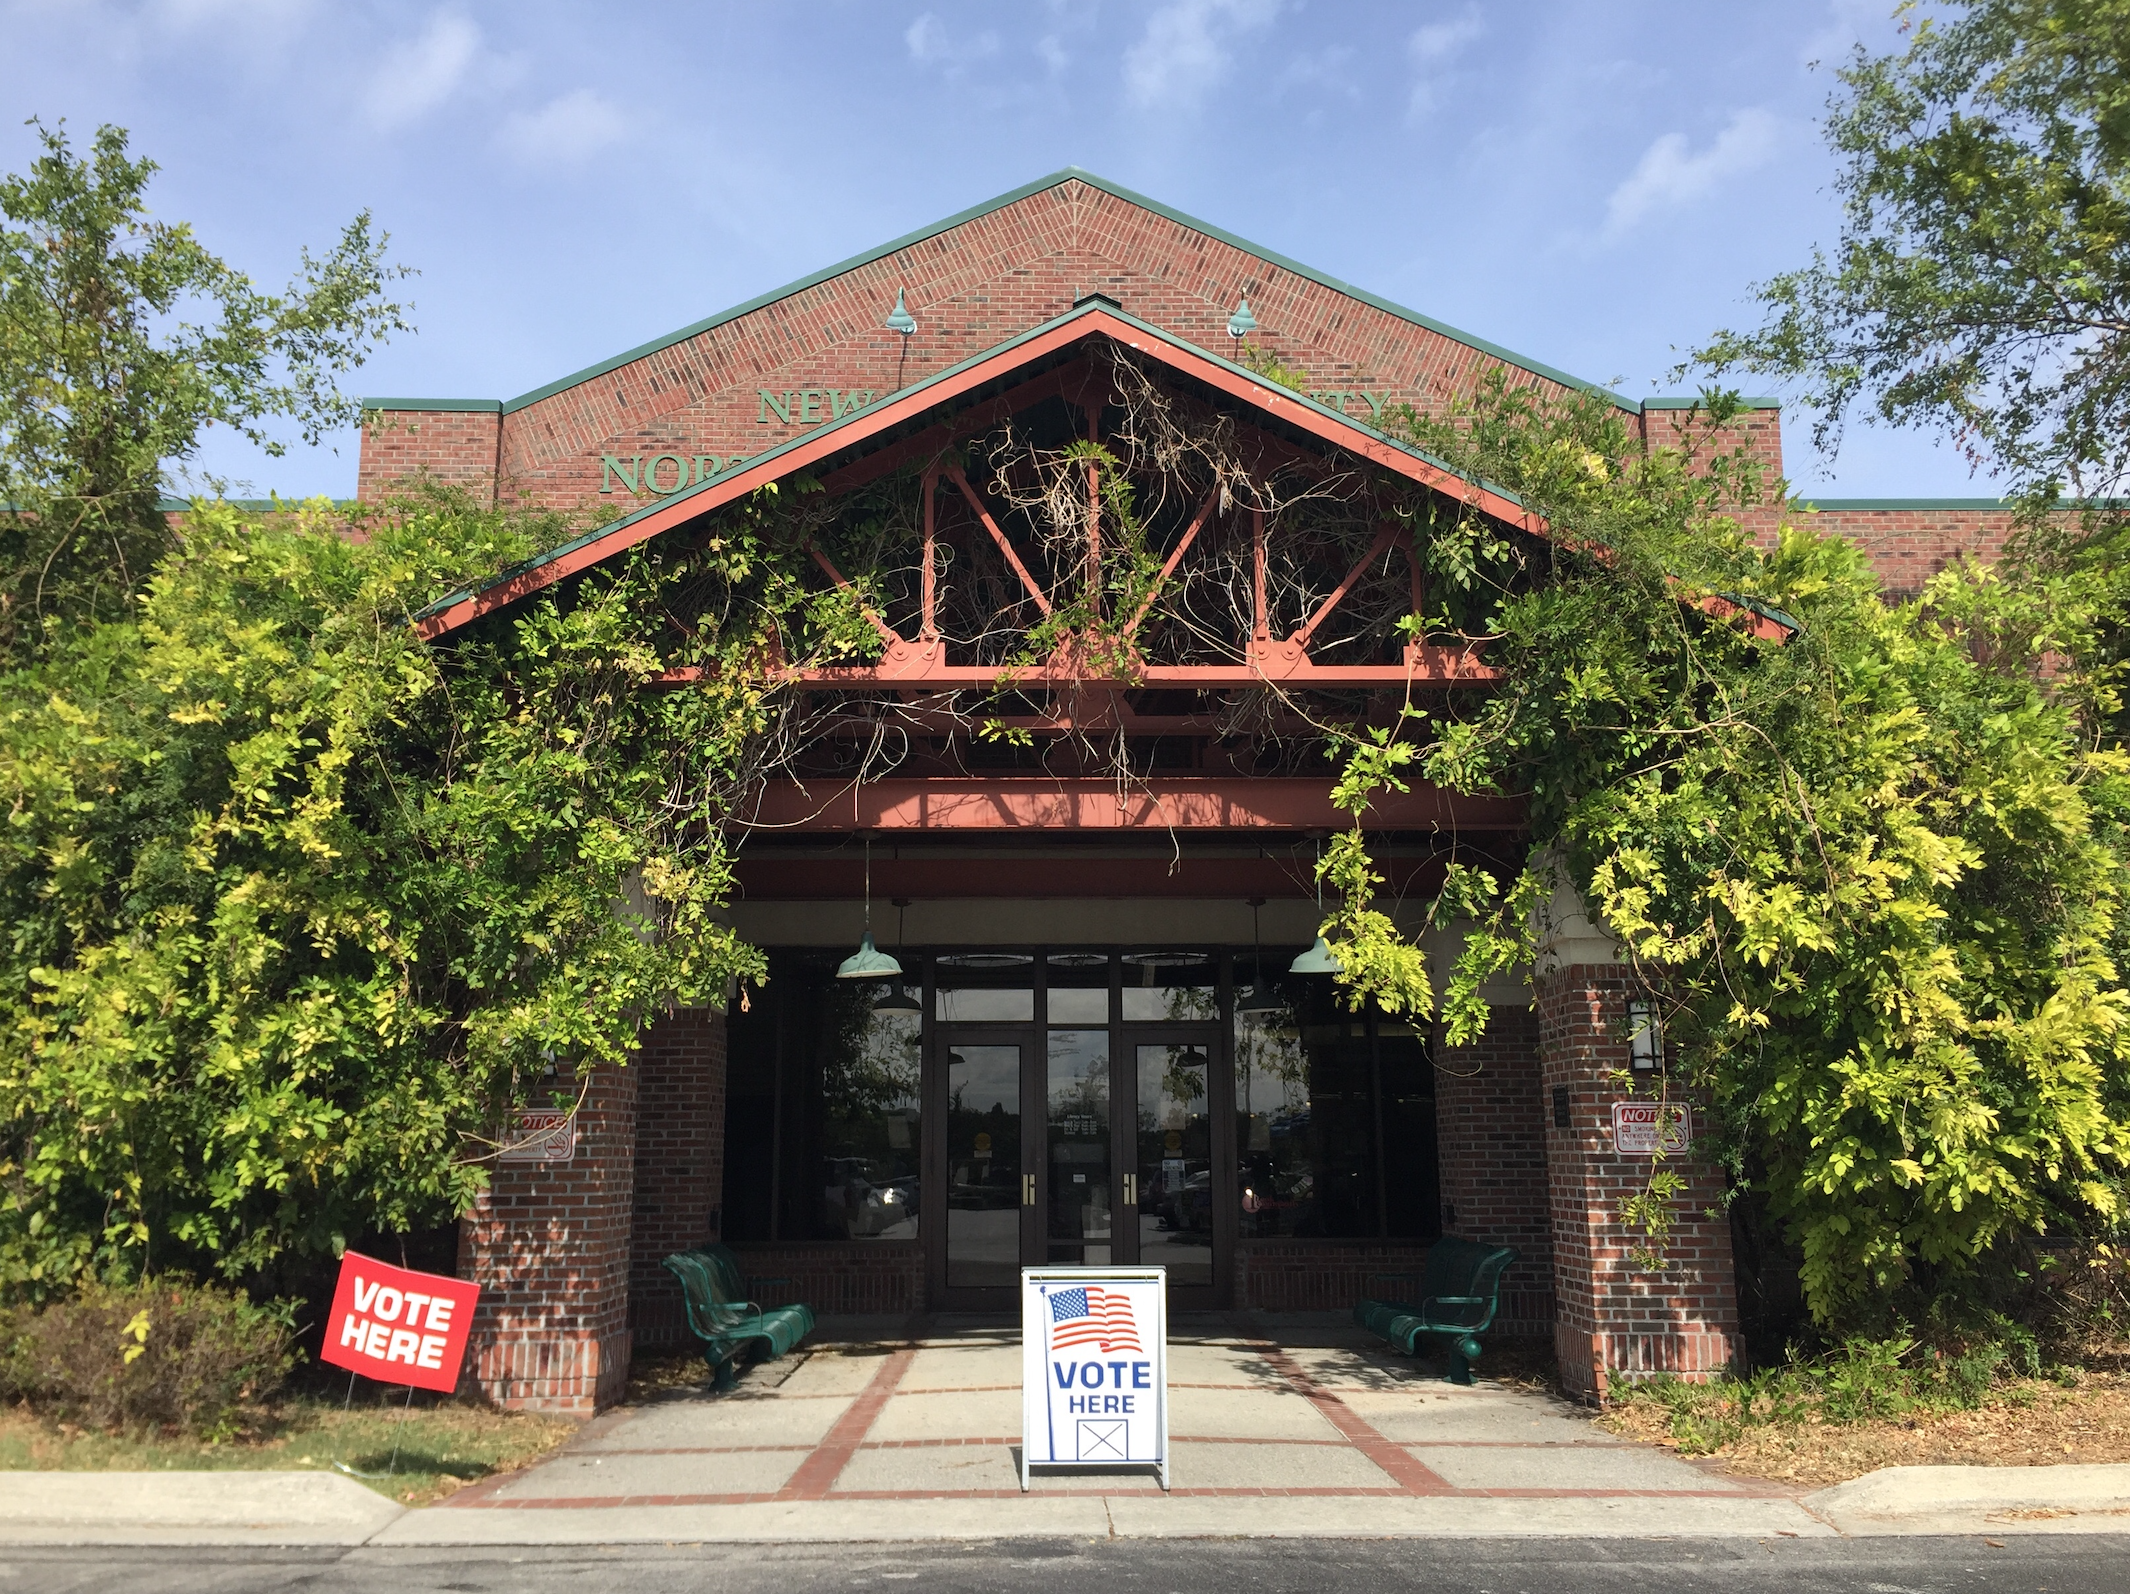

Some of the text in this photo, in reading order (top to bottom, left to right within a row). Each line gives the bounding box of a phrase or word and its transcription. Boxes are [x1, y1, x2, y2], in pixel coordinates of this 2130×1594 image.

[757, 389, 875, 424] NEW
[599, 454, 751, 495] NOR
[518, 1115, 566, 1128] OTICE
[354, 1276, 455, 1332] VOTE
[340, 1313, 447, 1369] HERE
[1053, 1361, 1151, 1389] VOTE
[1069, 1395, 1135, 1413] HERE
